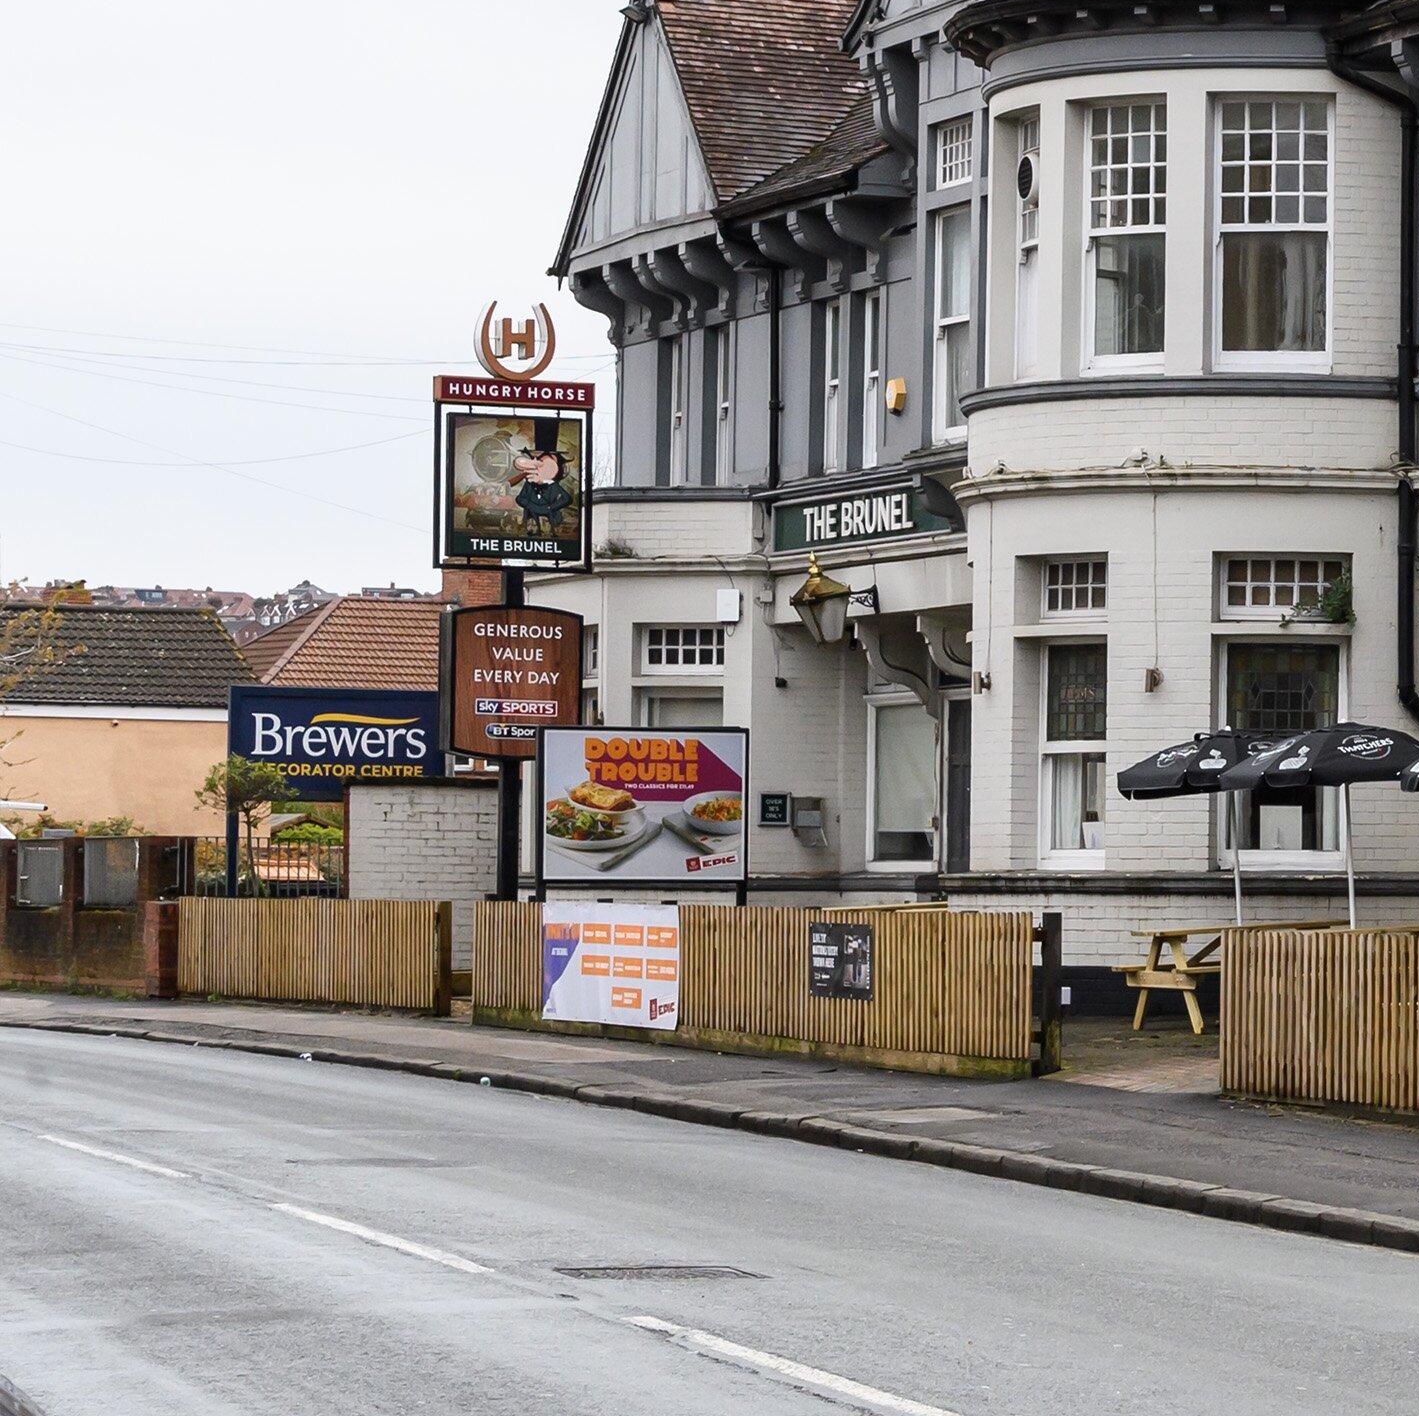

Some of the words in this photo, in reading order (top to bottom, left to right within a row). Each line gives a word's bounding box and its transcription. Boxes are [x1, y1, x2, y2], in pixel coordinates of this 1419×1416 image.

[449, 382, 522, 397] HUNGRY
[527, 387, 586, 401] HORSE
[803, 503, 837, 542] THE
[841, 493, 914, 537] BRUNEL
[470, 538, 499, 551] THE
[503, 540, 562, 553] BRUNEL
[474, 623, 563, 640] GENEROUS
[492, 647, 543, 661] VALUE
[474, 669, 523, 683] EVERY
[527, 671, 560, 685] DAY
[478, 701, 499, 714] sky
[502, 702, 554, 714] SPORTS
[251, 712, 427, 759] Brewers
[493, 726, 509, 735] BT
[510, 726, 536, 737] Spor
[585, 737, 700, 761] DOUBLE
[1337, 737, 1394, 754] THATCHERS
[256, 763, 356, 777] ECORATOR
[360, 764, 424, 777] CENTRE
[585, 761, 699, 782] TROUBLE
[701, 855, 736, 868] EPIC
